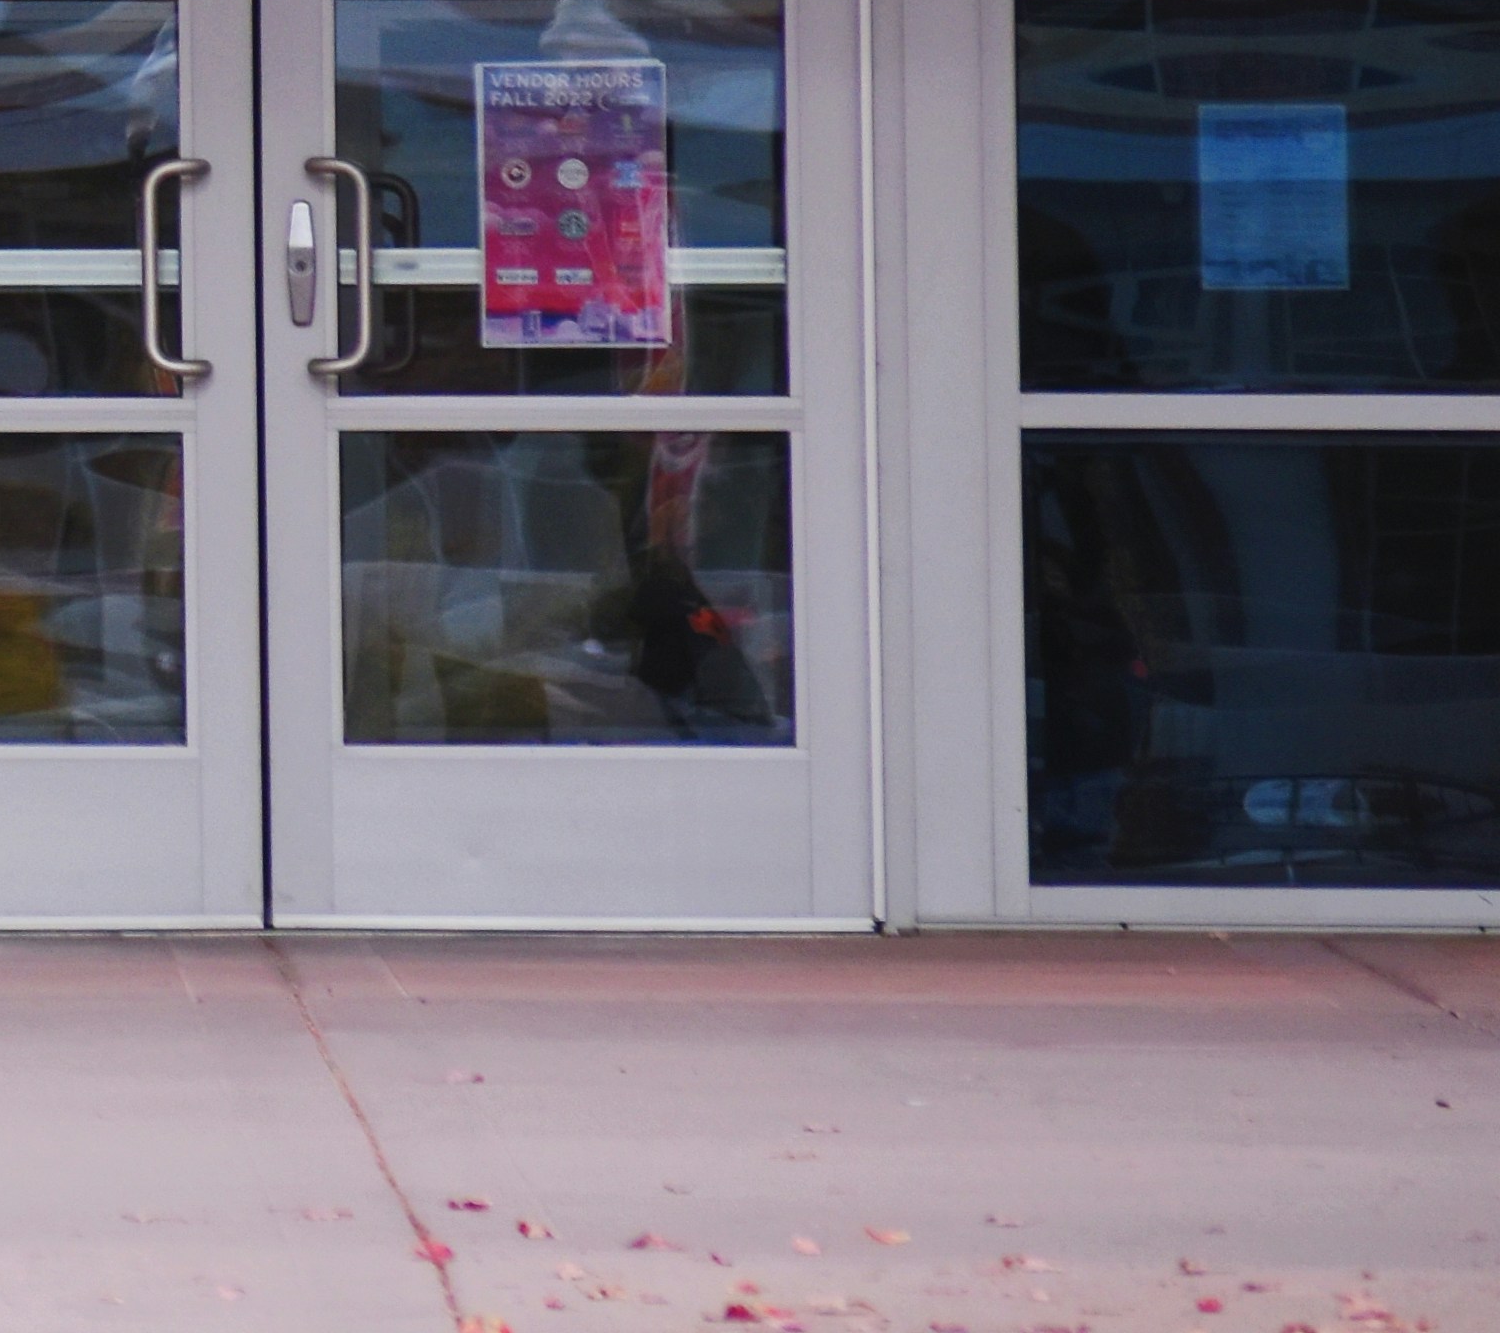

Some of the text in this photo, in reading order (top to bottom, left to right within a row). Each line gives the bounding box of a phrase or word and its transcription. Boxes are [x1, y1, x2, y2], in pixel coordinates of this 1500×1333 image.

[490, 73, 644, 88] VENDOR HOURS
[490, 91, 593, 106] FALL 2022
